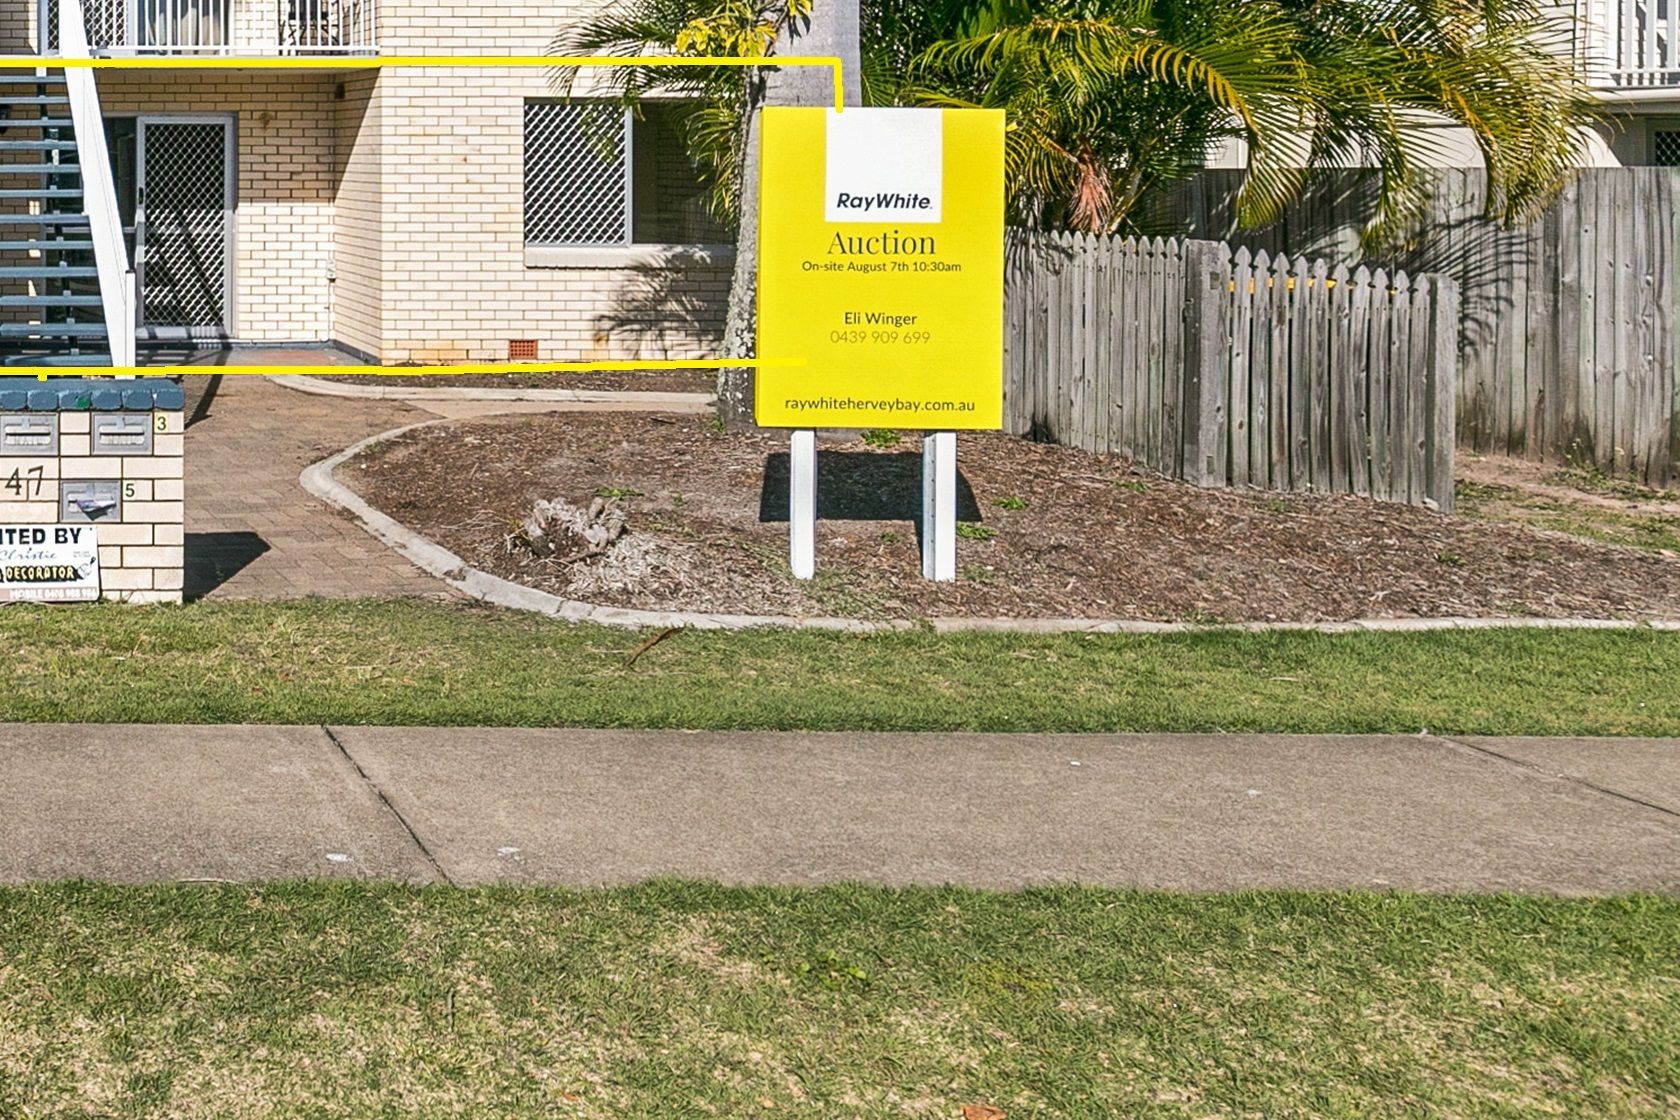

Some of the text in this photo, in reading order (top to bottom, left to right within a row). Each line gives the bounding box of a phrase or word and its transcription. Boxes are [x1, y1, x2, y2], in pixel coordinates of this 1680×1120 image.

[827, 229, 936, 255] Auction
[801, 261, 962, 274] On-site August 7th 10:30am
[844, 312, 918, 328] Eli Winger
[830, 330, 931, 345] 0439 909 699
[785, 397, 976, 413] raywhiteherveybay.com.au
[156, 416, 167, 431] 3
[4, 464, 45, 496] 47
[125, 483, 135, 498] 5
[54, 527, 82, 544] BY
[5, 565, 77, 581] DECORATOR
[9, 589, 42, 599] MOBILE
